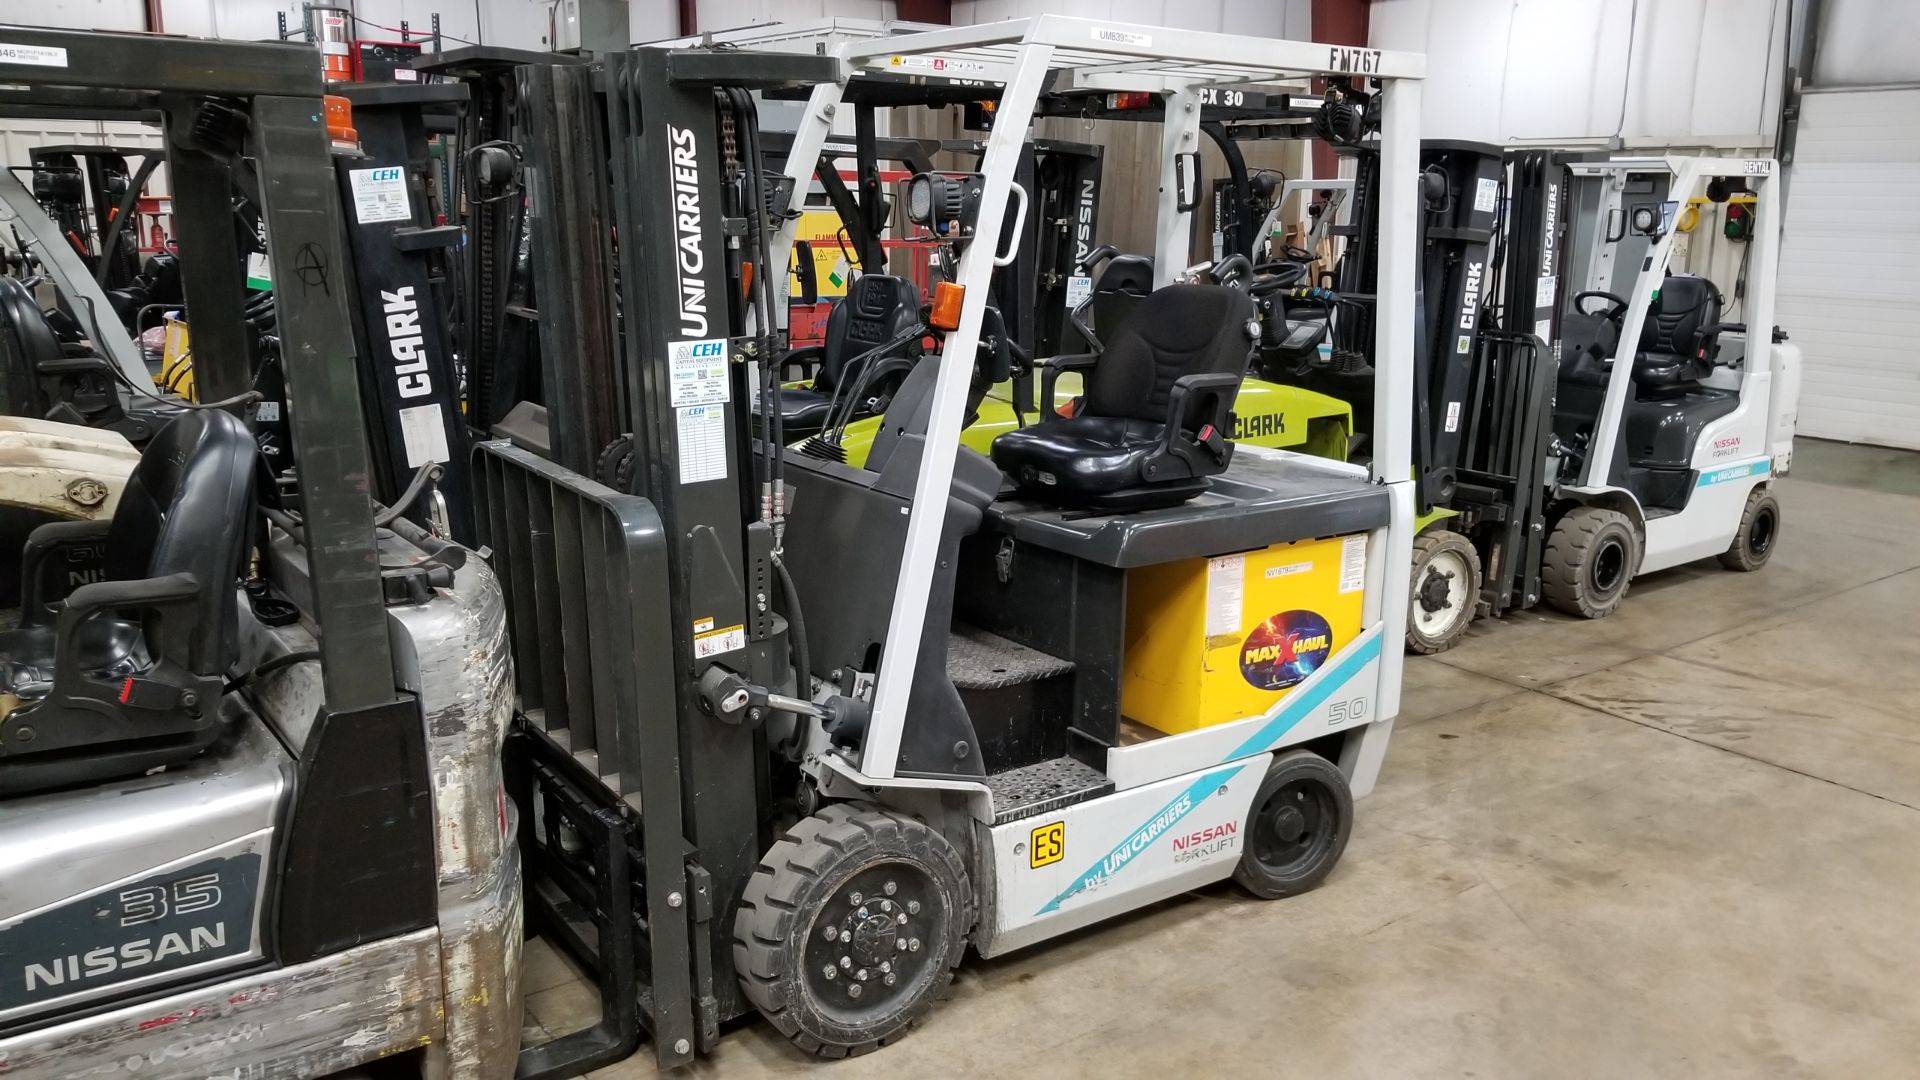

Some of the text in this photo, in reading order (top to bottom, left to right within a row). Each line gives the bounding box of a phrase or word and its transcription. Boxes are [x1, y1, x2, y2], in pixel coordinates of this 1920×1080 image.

[1330, 48, 1381, 73] FM767
[1224, 90, 1244, 106] 30
[372, 169, 399, 181] CEH
[1743, 161, 1771, 174] RENTAL
[1459, 262, 1482, 329] CLARK
[380, 285, 432, 399] CLARK
[692, 342, 723, 357] CEH
[689, 406, 705, 415] CEH
[1232, 412, 1285, 440] CLARK
[1714, 437, 1741, 449] NISSAN
[1292, 634, 1329, 655] HAUL
[1328, 696, 1368, 726] 50
[1034, 827, 1061, 862] ES
[1172, 820, 1237, 852] NISSAN
[120, 872, 222, 928] 35
[24, 921, 226, 992] NISSAN
